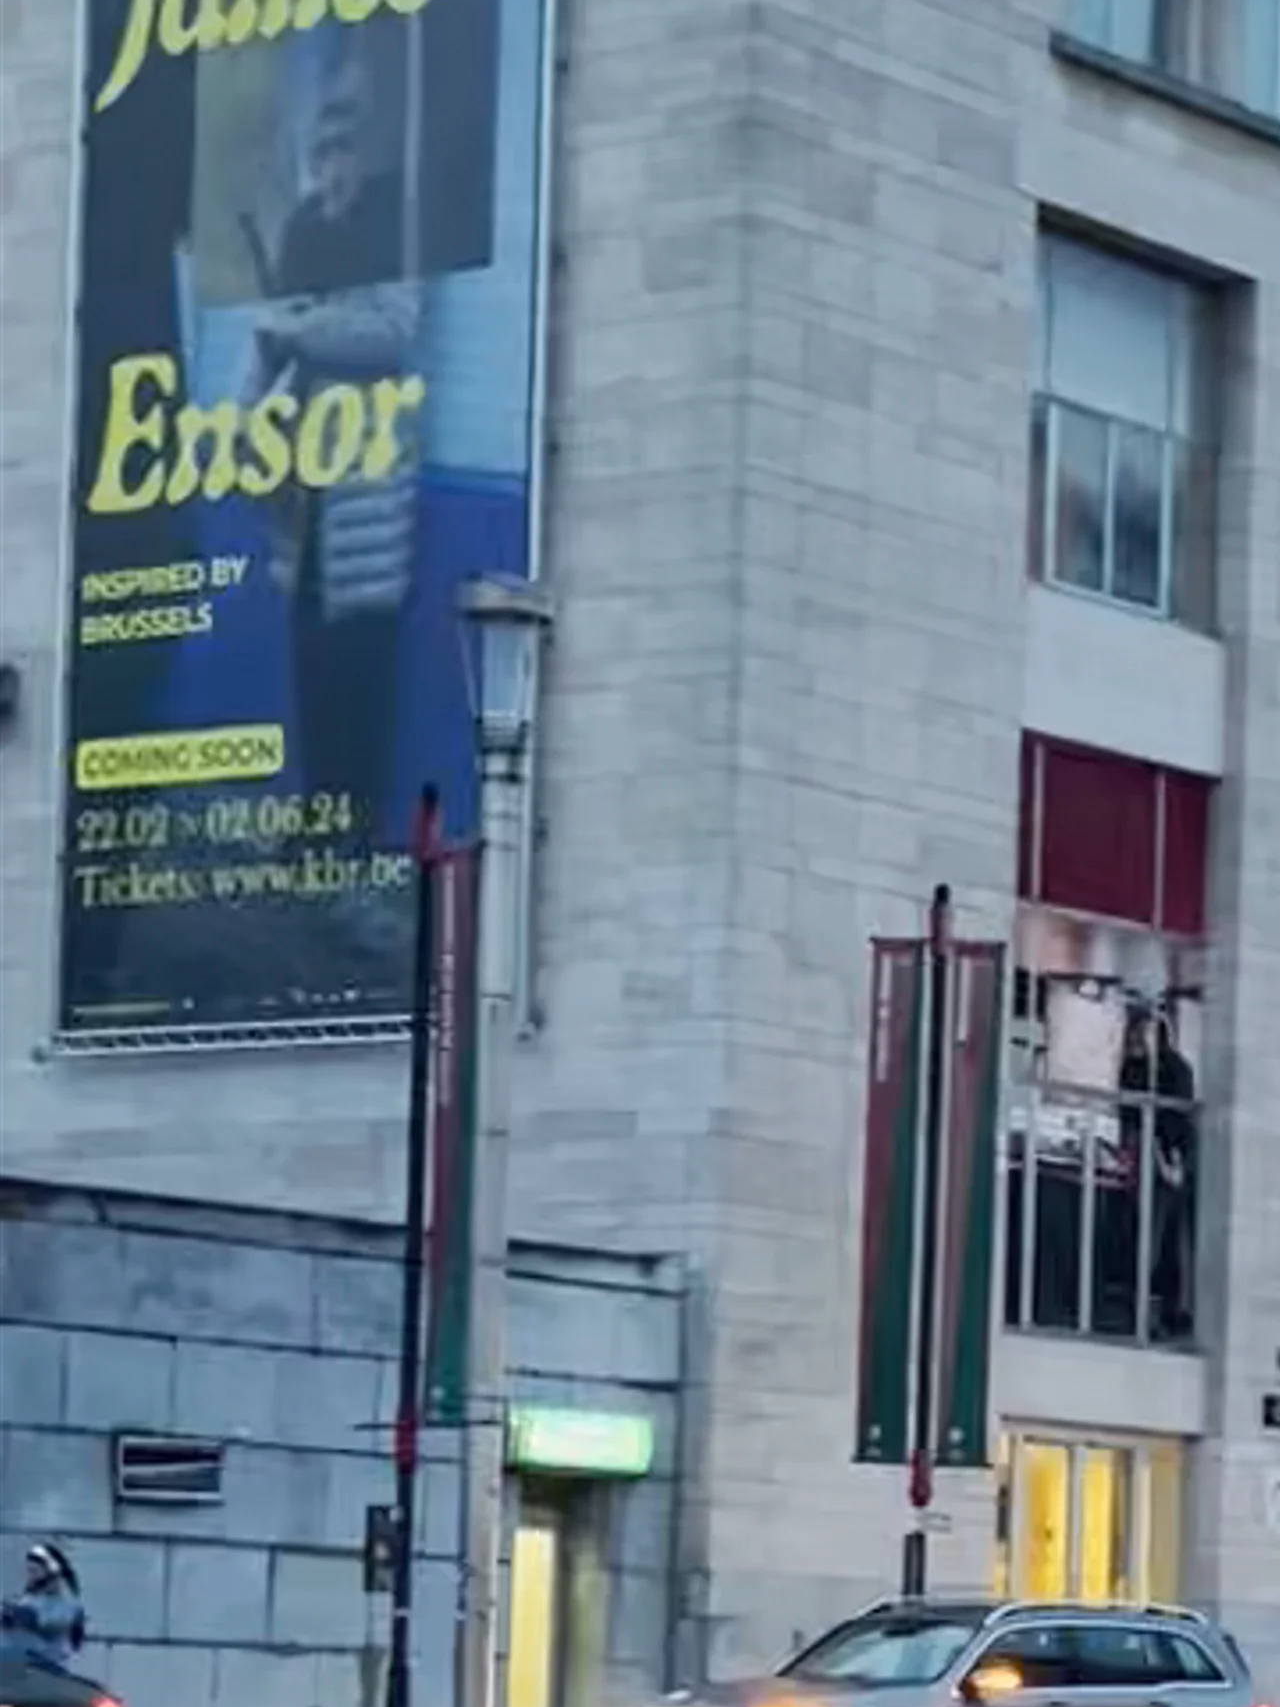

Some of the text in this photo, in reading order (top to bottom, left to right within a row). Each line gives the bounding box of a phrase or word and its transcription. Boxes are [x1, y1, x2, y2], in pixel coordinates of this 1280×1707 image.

[87, 351, 425, 514] Ensor
[83, 555, 249, 603] INSPIRED BY
[82, 601, 213, 646] BRUSSELS
[83, 737, 277, 780] COMING SOON
